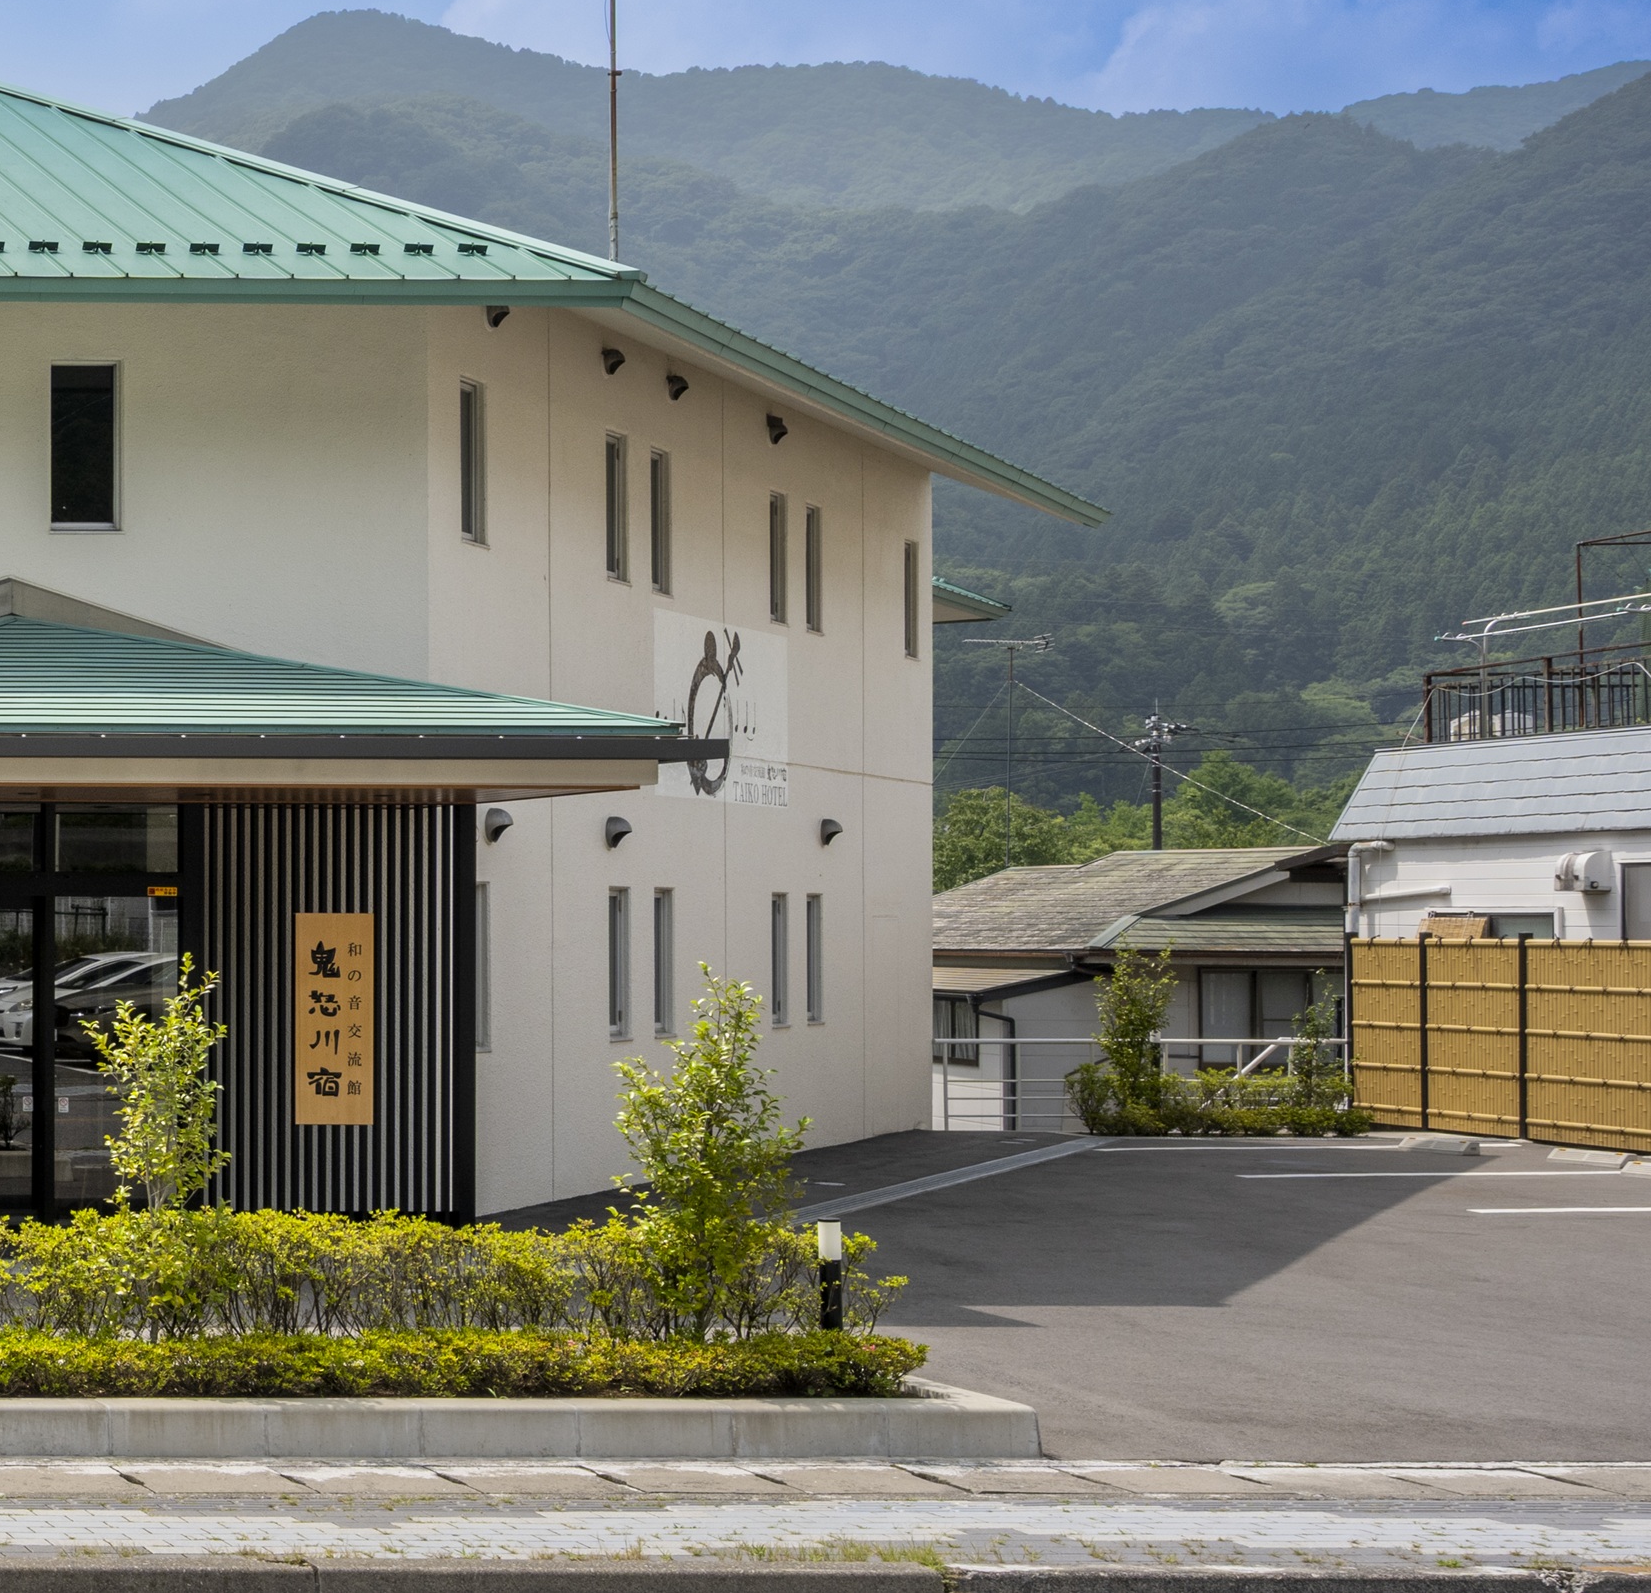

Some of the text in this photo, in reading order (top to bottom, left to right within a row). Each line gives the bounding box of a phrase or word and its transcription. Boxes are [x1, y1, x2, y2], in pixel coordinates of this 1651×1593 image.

[733, 780, 788, 807] TAIKO HOTEL
[306, 940, 343, 1097] 鬼怒川宿
[346, 942, 362, 1096] 和の音交流館
